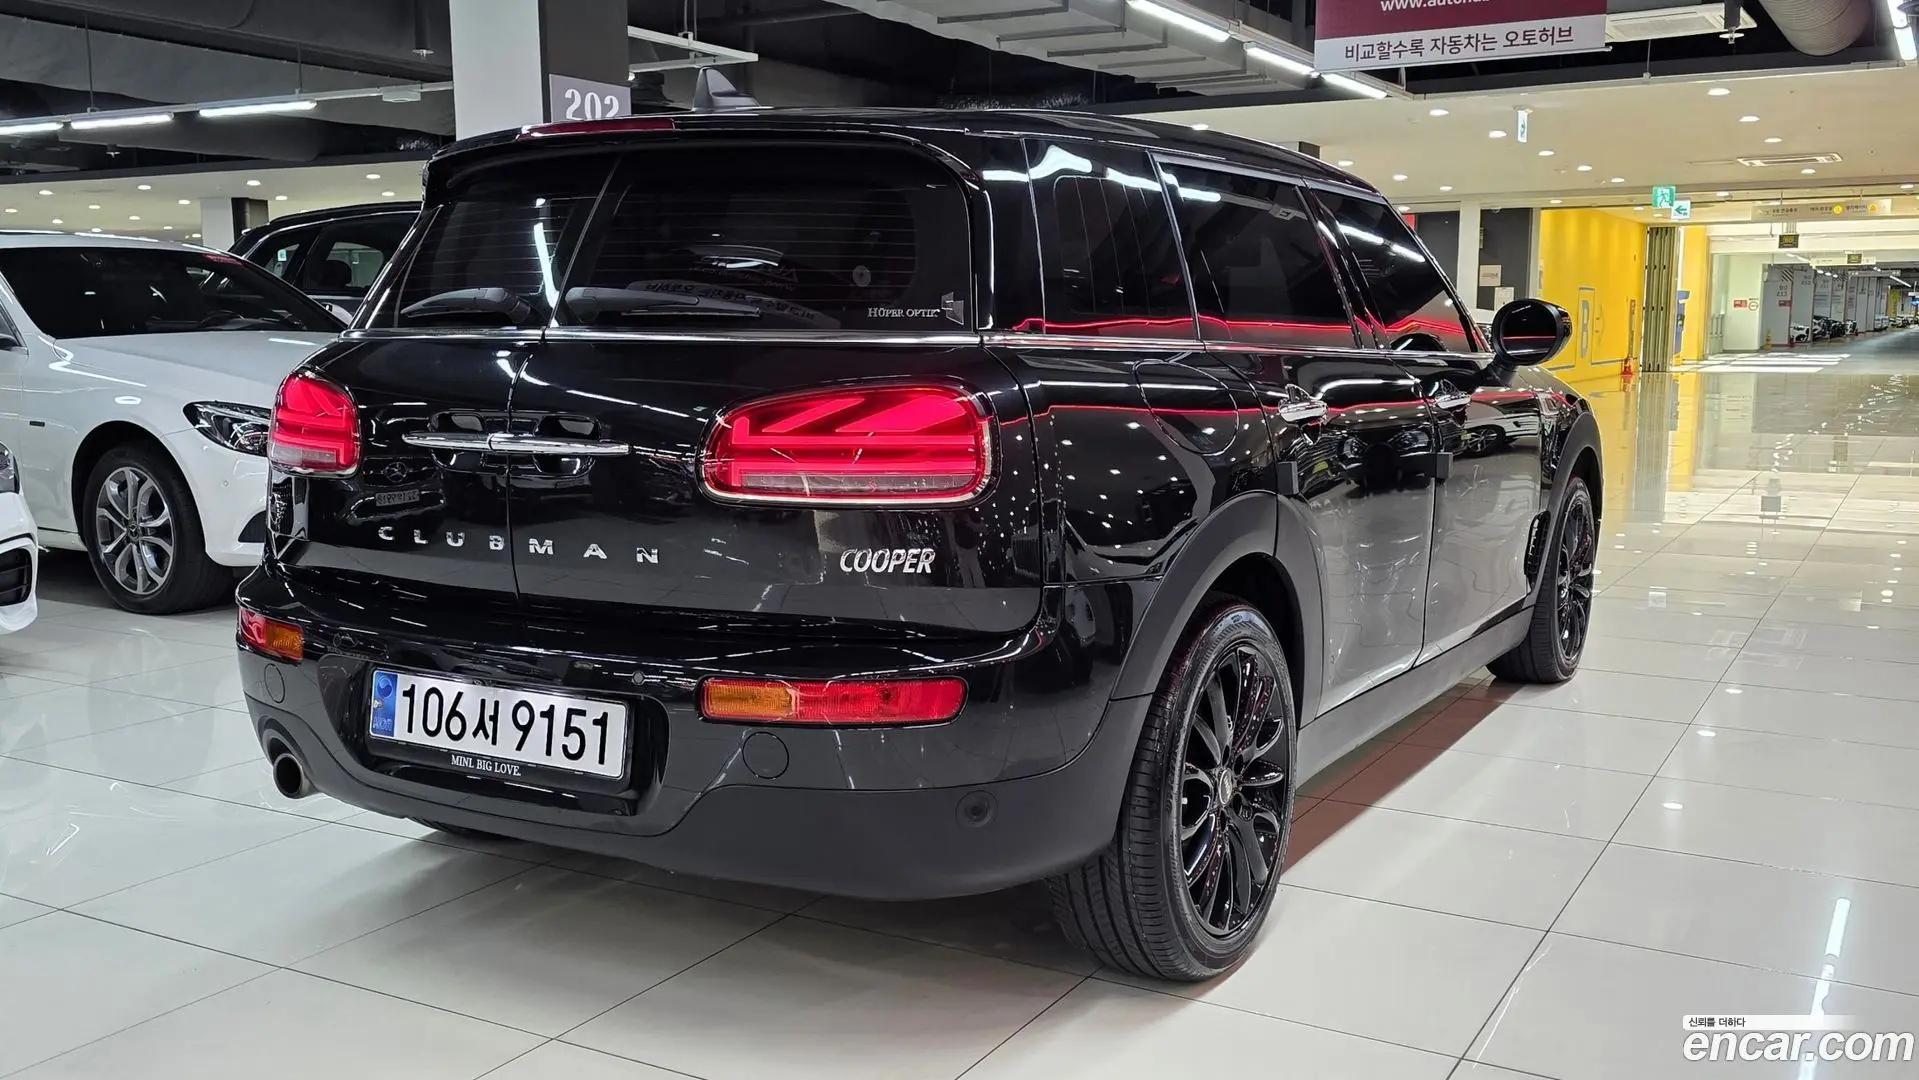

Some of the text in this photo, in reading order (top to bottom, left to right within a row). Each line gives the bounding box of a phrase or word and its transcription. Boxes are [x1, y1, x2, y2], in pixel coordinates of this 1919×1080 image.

[1345, 26, 1575, 62] 비교할수록 자동차는 오토허브
[565, 88, 620, 121] 202
[378, 526, 659, 564] CLUBMAN
[839, 548, 936, 574] COOPER
[402, 683, 609, 765] 106서 9151
[476, 758, 493, 771] BIG
[494, 761, 522, 776] LOVE.
